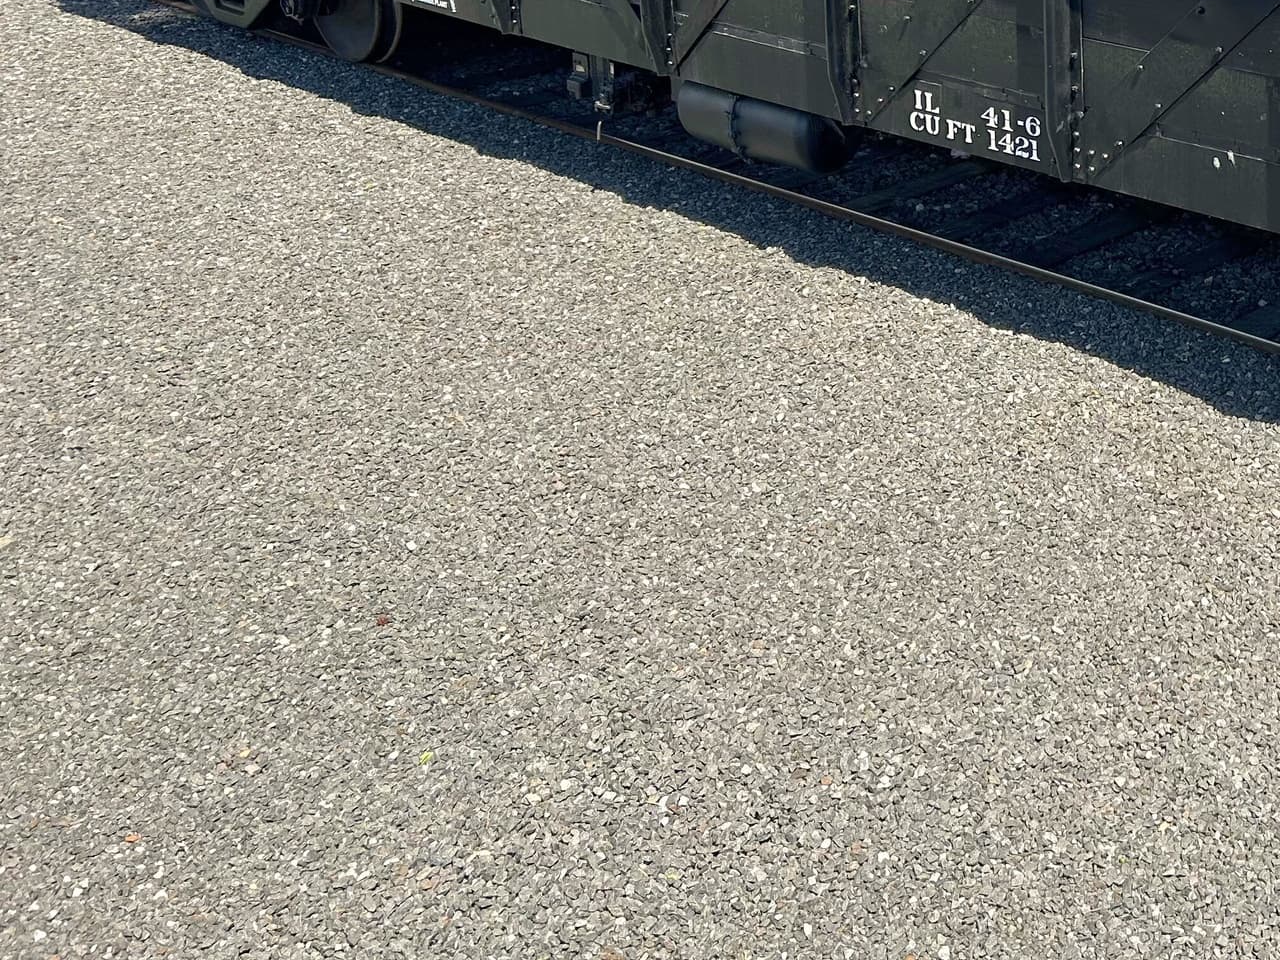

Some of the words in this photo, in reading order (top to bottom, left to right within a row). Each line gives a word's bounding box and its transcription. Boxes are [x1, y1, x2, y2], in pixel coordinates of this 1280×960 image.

[909, 111, 941, 136] CU
[945, 118, 976, 144] FT
[987, 129, 1041, 162] 1421
[914, 89, 940, 114] IL
[980, 106, 1041, 137] 41-6
